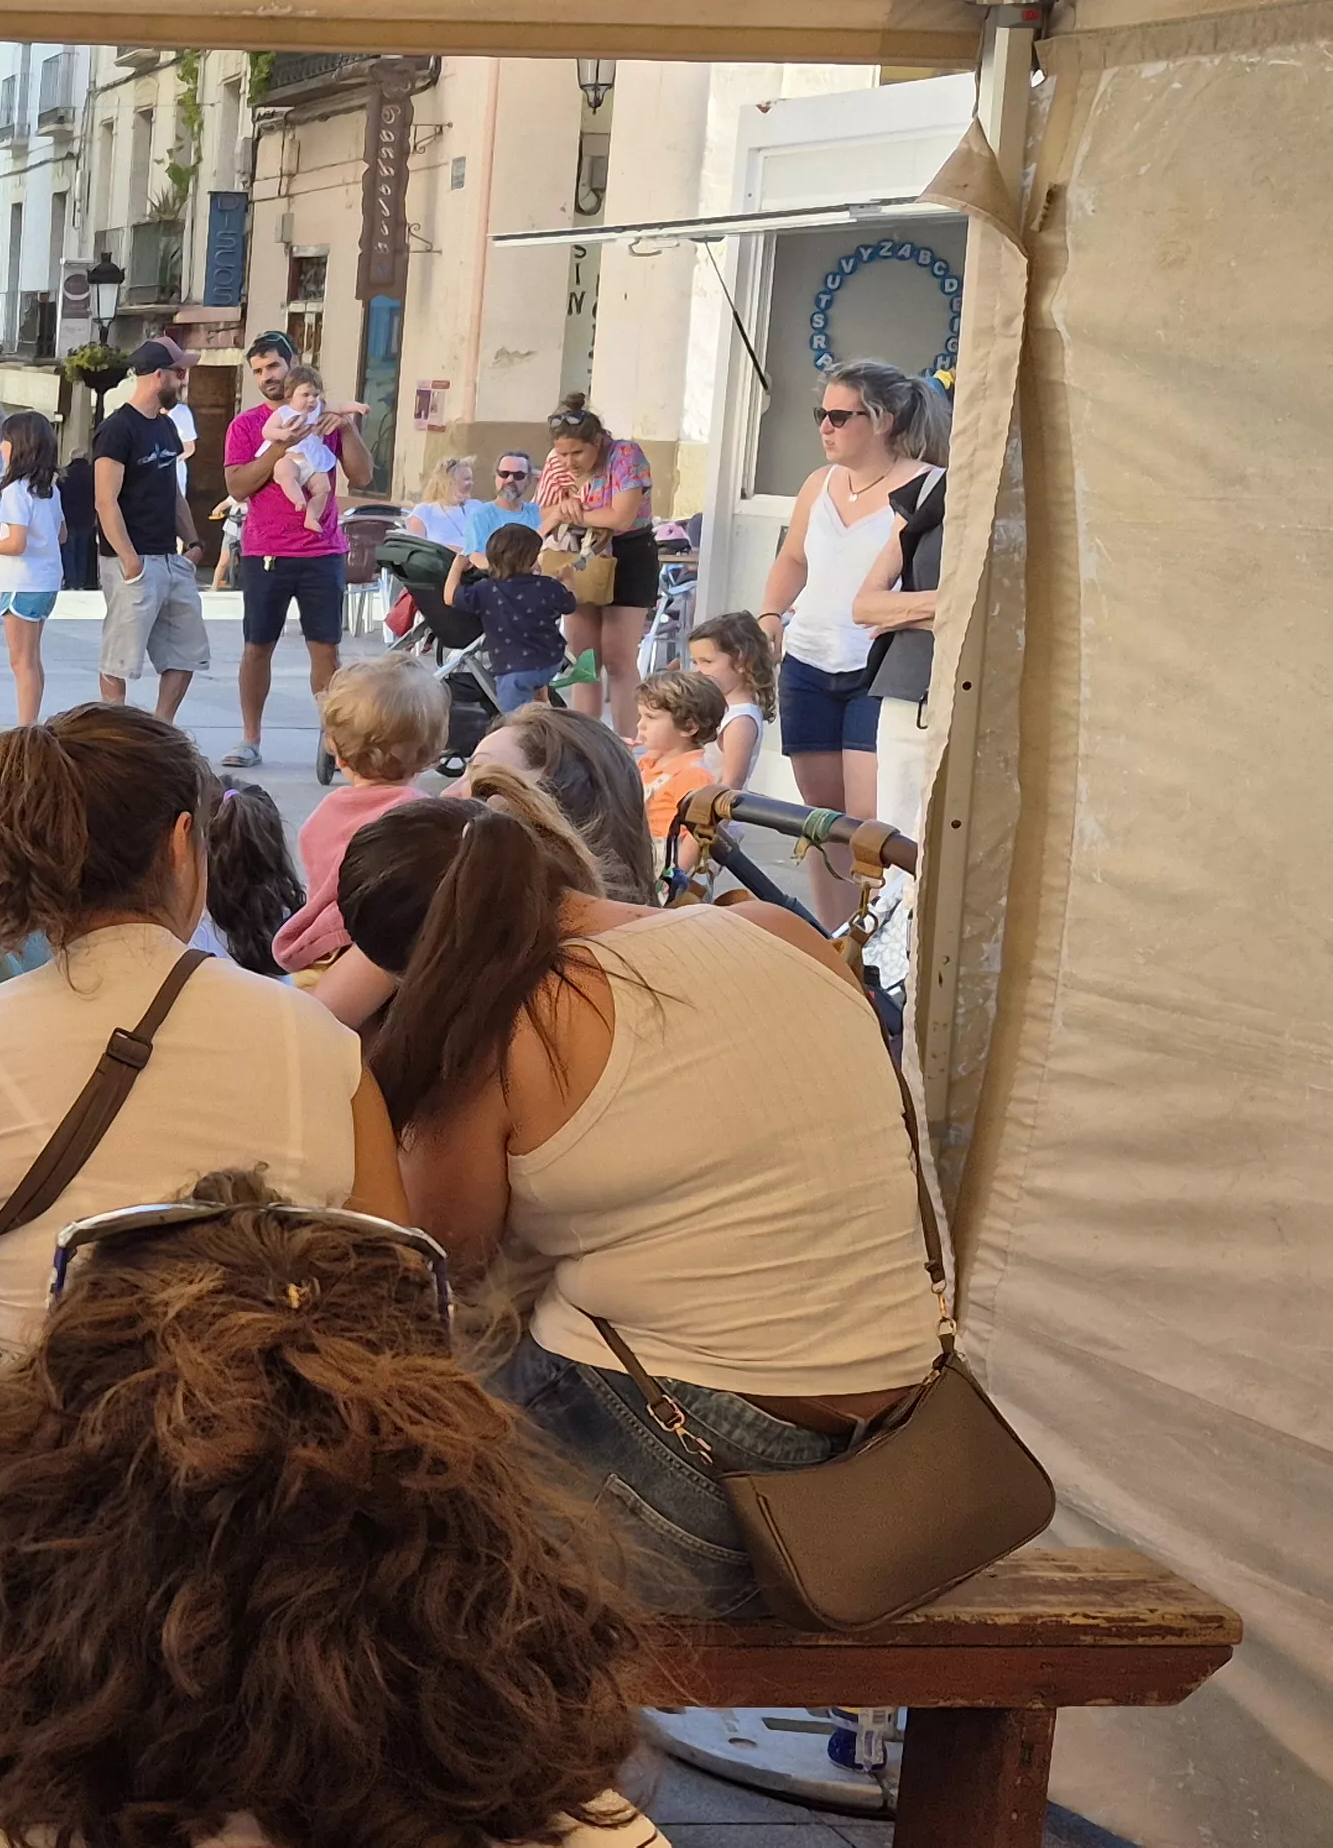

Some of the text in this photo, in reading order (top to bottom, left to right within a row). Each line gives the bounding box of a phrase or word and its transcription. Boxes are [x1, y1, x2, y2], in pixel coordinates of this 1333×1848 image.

[859, 248, 872, 260] Y
[880, 242, 892, 255] Z
[898, 244, 910, 257] A
[919, 250, 931, 264] B
[841, 259, 854, 273] V
[933, 263, 947, 276] C
[827, 275, 840, 289] U
[945, 279, 957, 292] D
[818, 294, 831, 308] T
[812, 314, 825, 328] S
[813, 335, 826, 349] R
[936, 355, 950, 369] H
